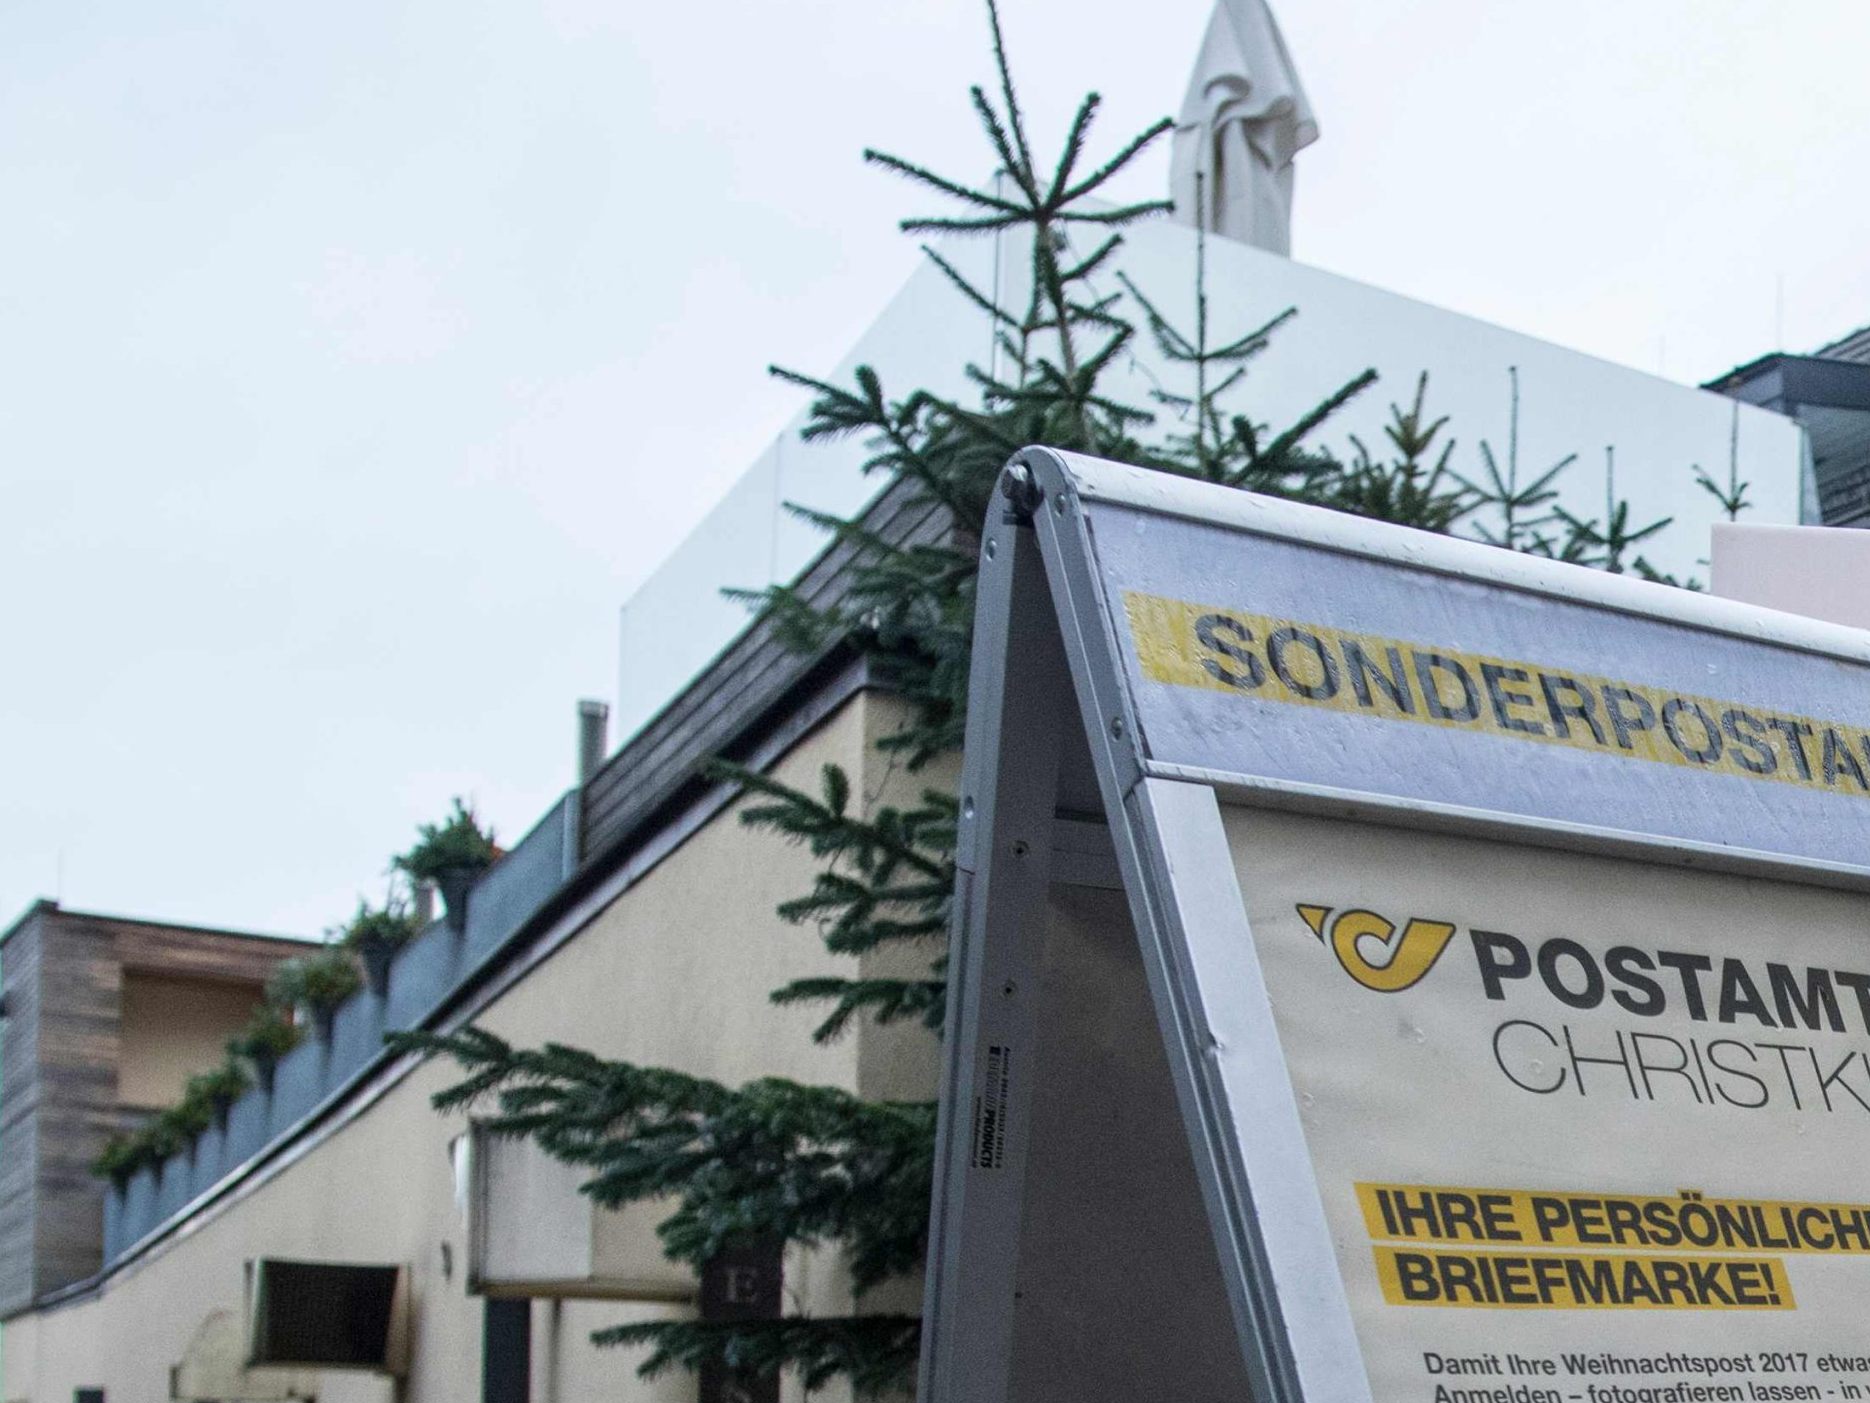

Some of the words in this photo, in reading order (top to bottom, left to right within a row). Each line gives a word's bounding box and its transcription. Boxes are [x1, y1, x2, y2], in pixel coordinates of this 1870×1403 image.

[1375, 1189, 1523, 1241] IHRE
[1394, 1252, 1782, 1305] BRIEFMARKE!
[1423, 1352, 1503, 1374] Damit
[1507, 1354, 1556, 1375] Ihre
[1561, 1353, 1755, 1377] Weihnachtspost
[1759, 1353, 1807, 1372] 2017
[1748, 1382, 1821, 1401] lassen
[1839, 1381, 1861, 1399] in
